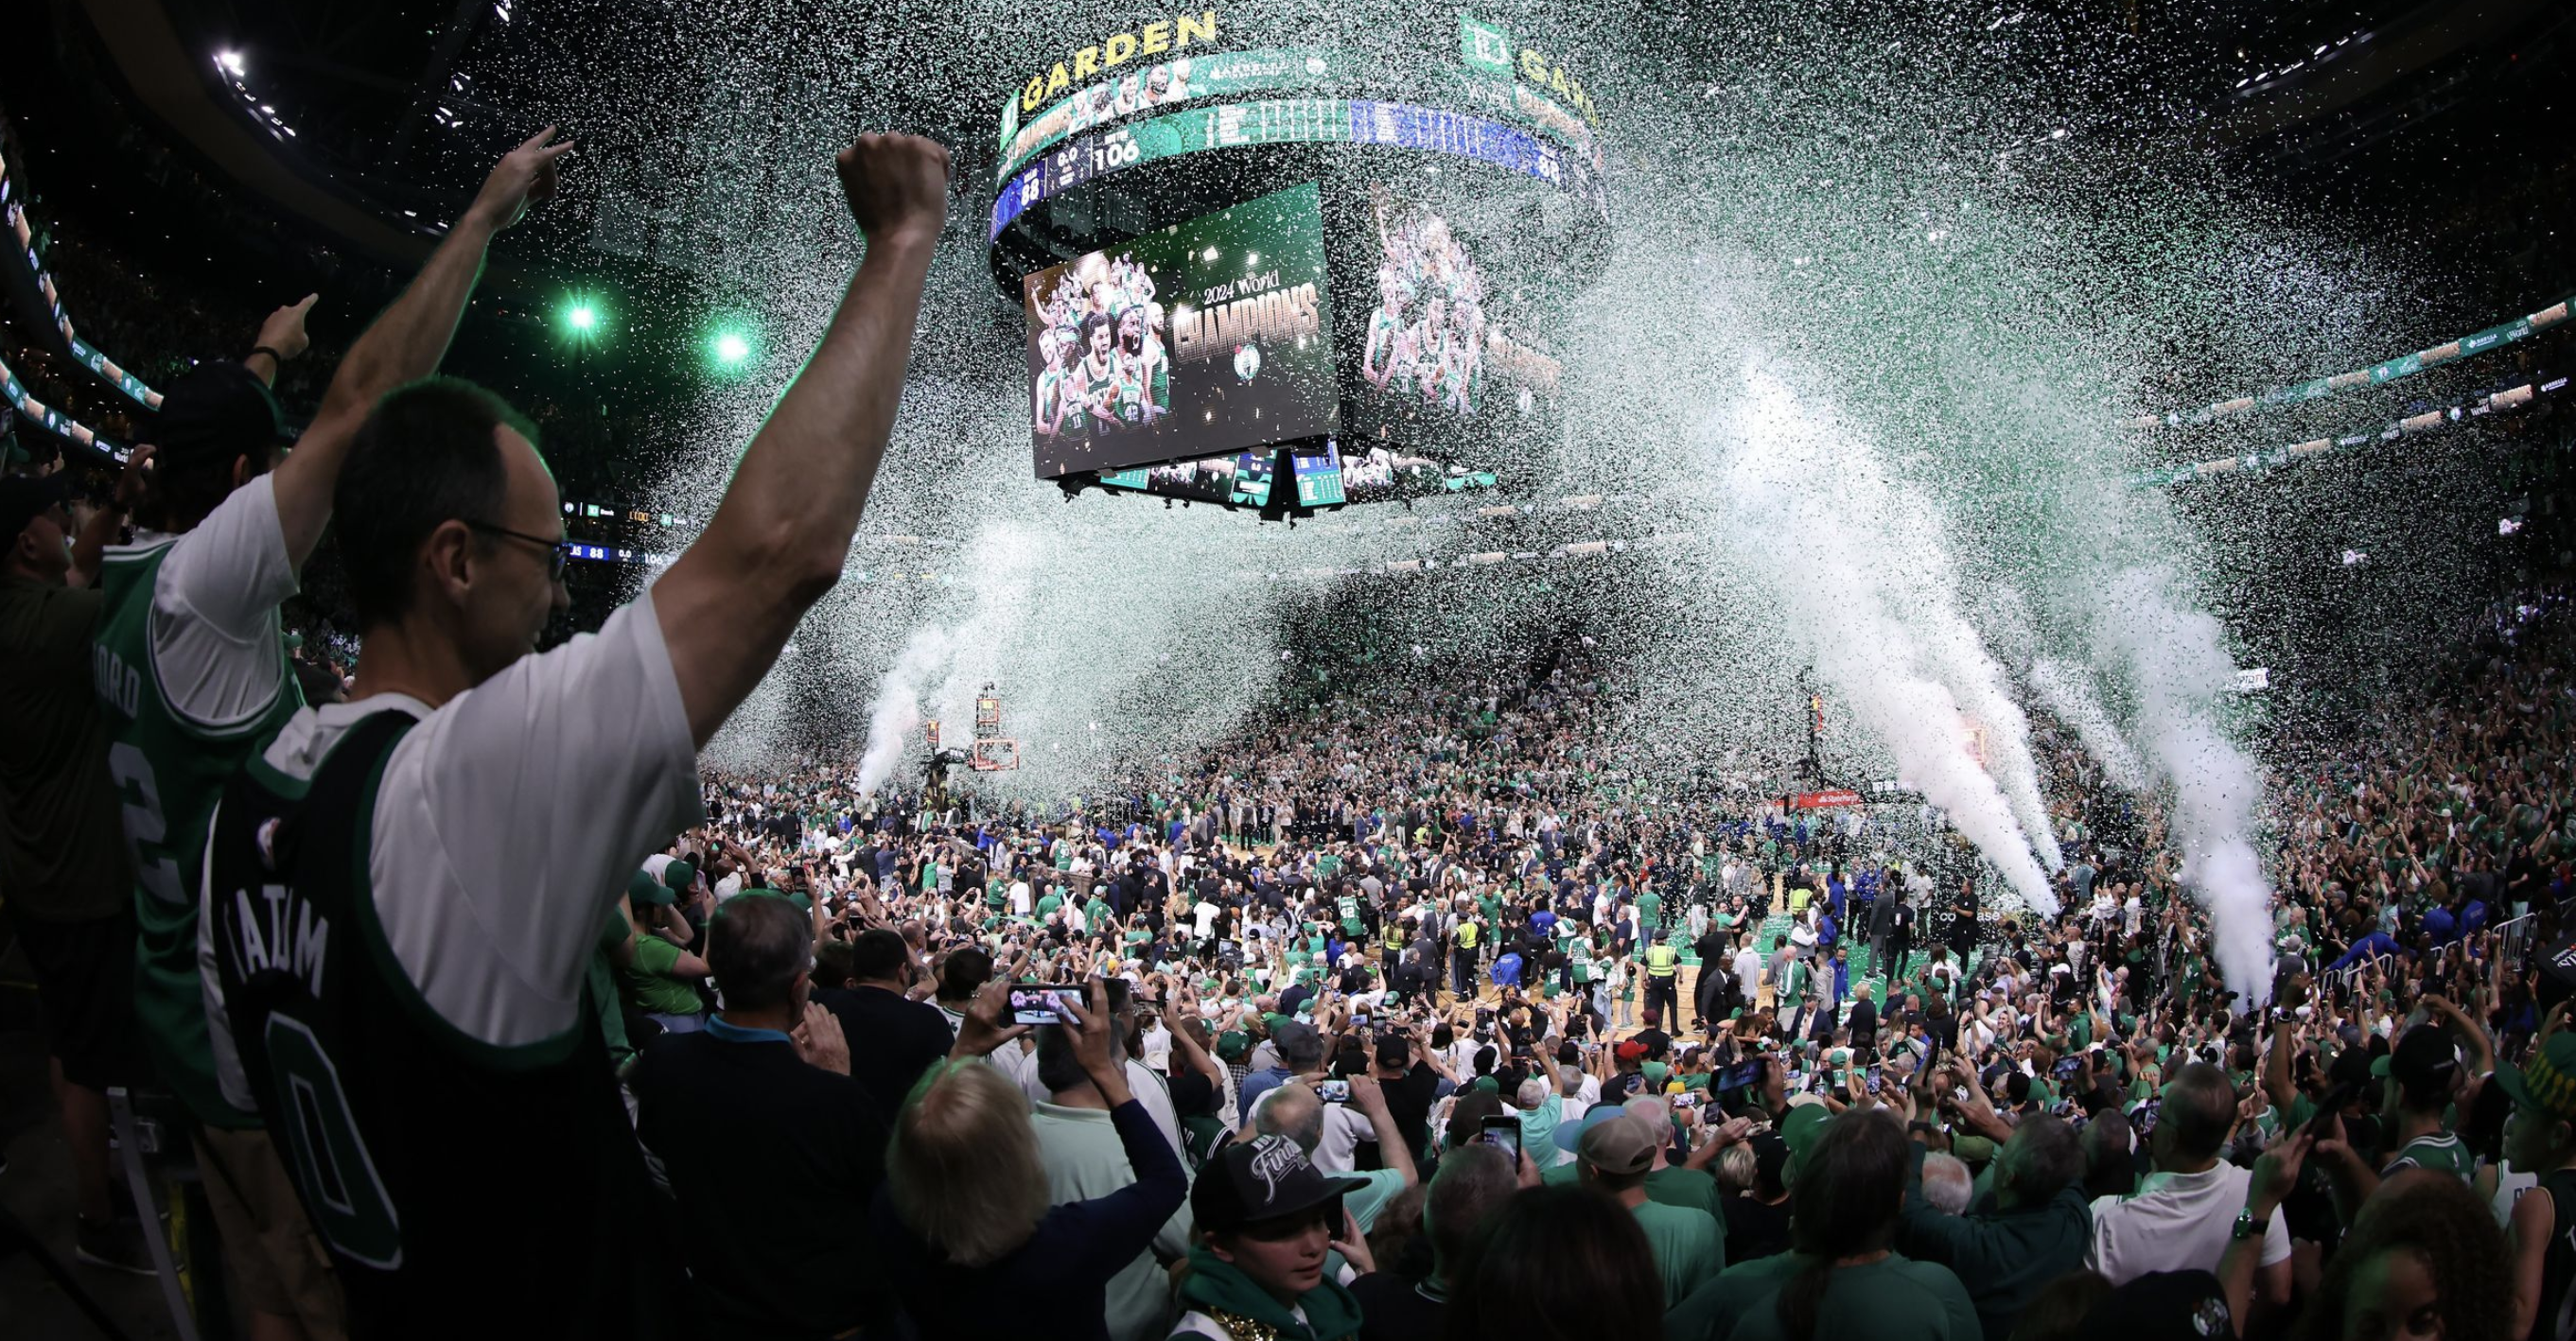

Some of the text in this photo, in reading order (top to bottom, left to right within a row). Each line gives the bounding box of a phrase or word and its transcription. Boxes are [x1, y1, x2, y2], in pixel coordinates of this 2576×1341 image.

[1023, 10, 1217, 112] GARDEN
[1094, 139, 1140, 171] 106
[1538, 154, 1561, 183] 88
[1022, 177, 1040, 206] 88
[1203, 269, 1280, 305] 2024 World
[1173, 282, 1321, 363] CHAMPIONS
[589, 547, 604, 559] 88
[645, 553, 662, 565] 106
[94, 642, 141, 719] ORD
[1939, 911, 2000, 922] coase
[265, 1010, 403, 1270] 0
